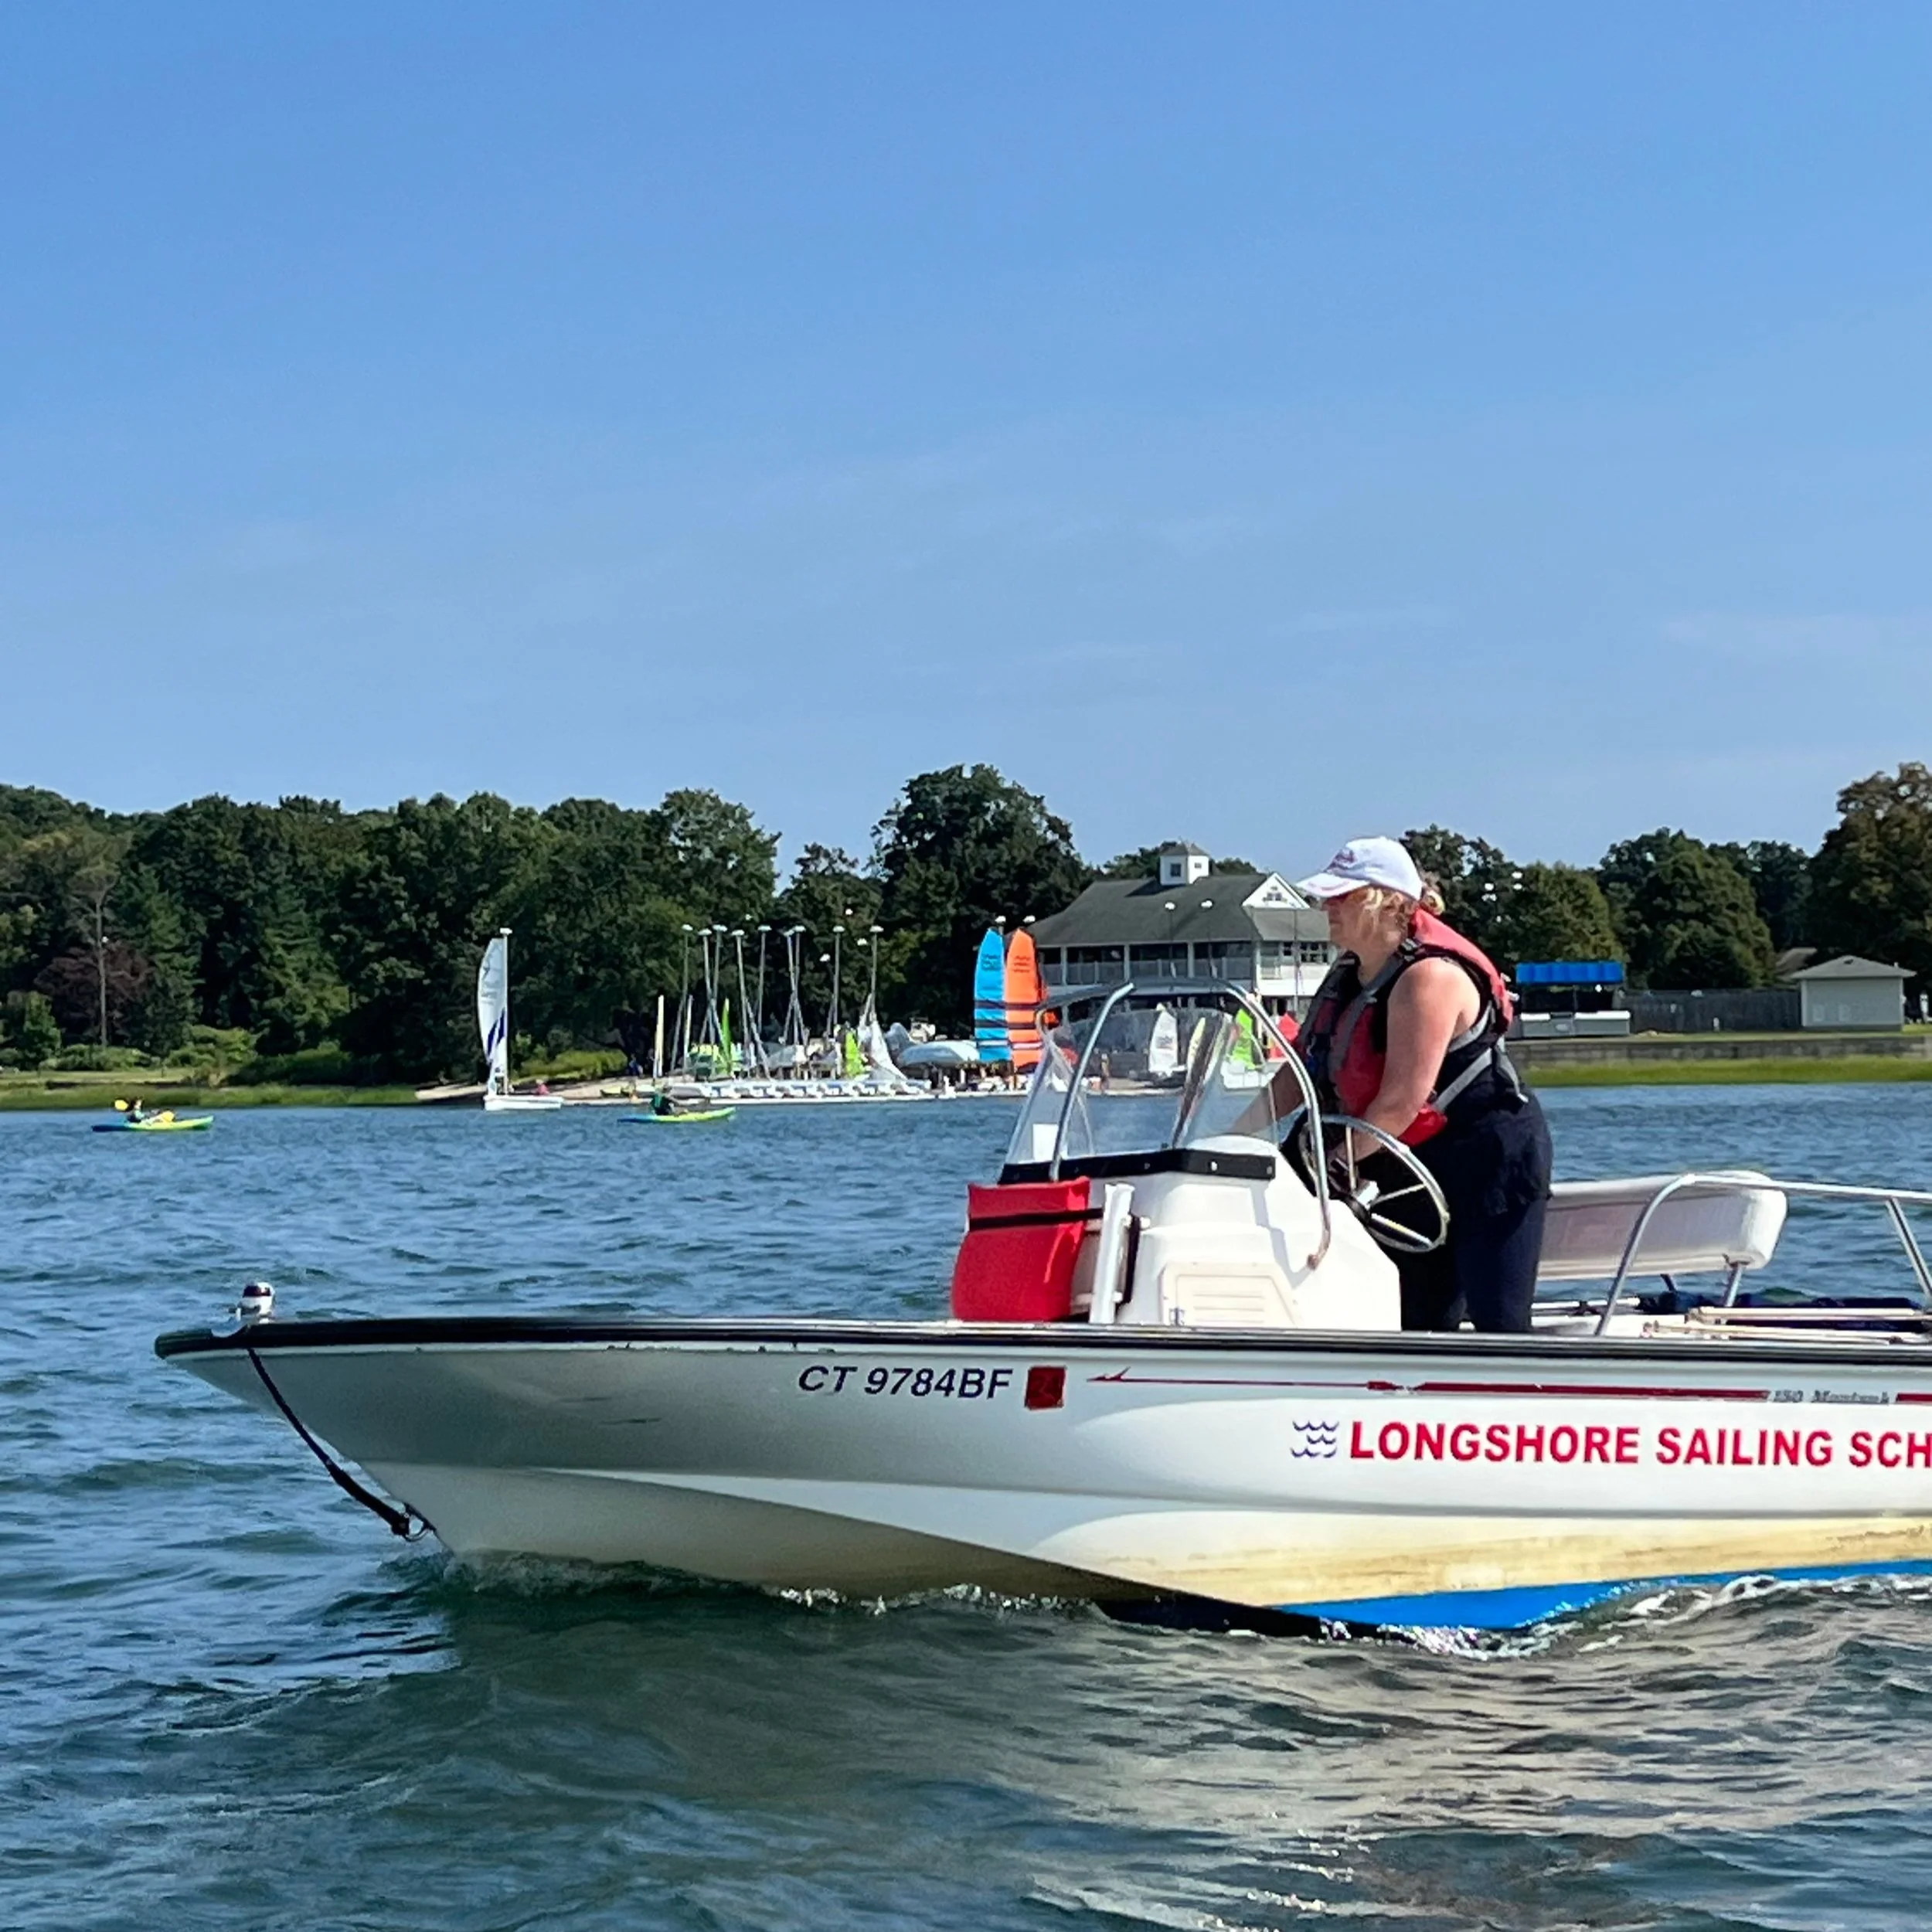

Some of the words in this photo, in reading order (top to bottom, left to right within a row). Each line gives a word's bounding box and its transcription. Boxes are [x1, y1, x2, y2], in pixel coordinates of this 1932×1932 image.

[798, 1365, 859, 1393] CT
[864, 1367, 1014, 1399] 9784BF
[1350, 1421, 1640, 1464] LONGSHORE
[1656, 1427, 1834, 1467] SAILING
[1849, 1430, 1932, 1468] SCH
